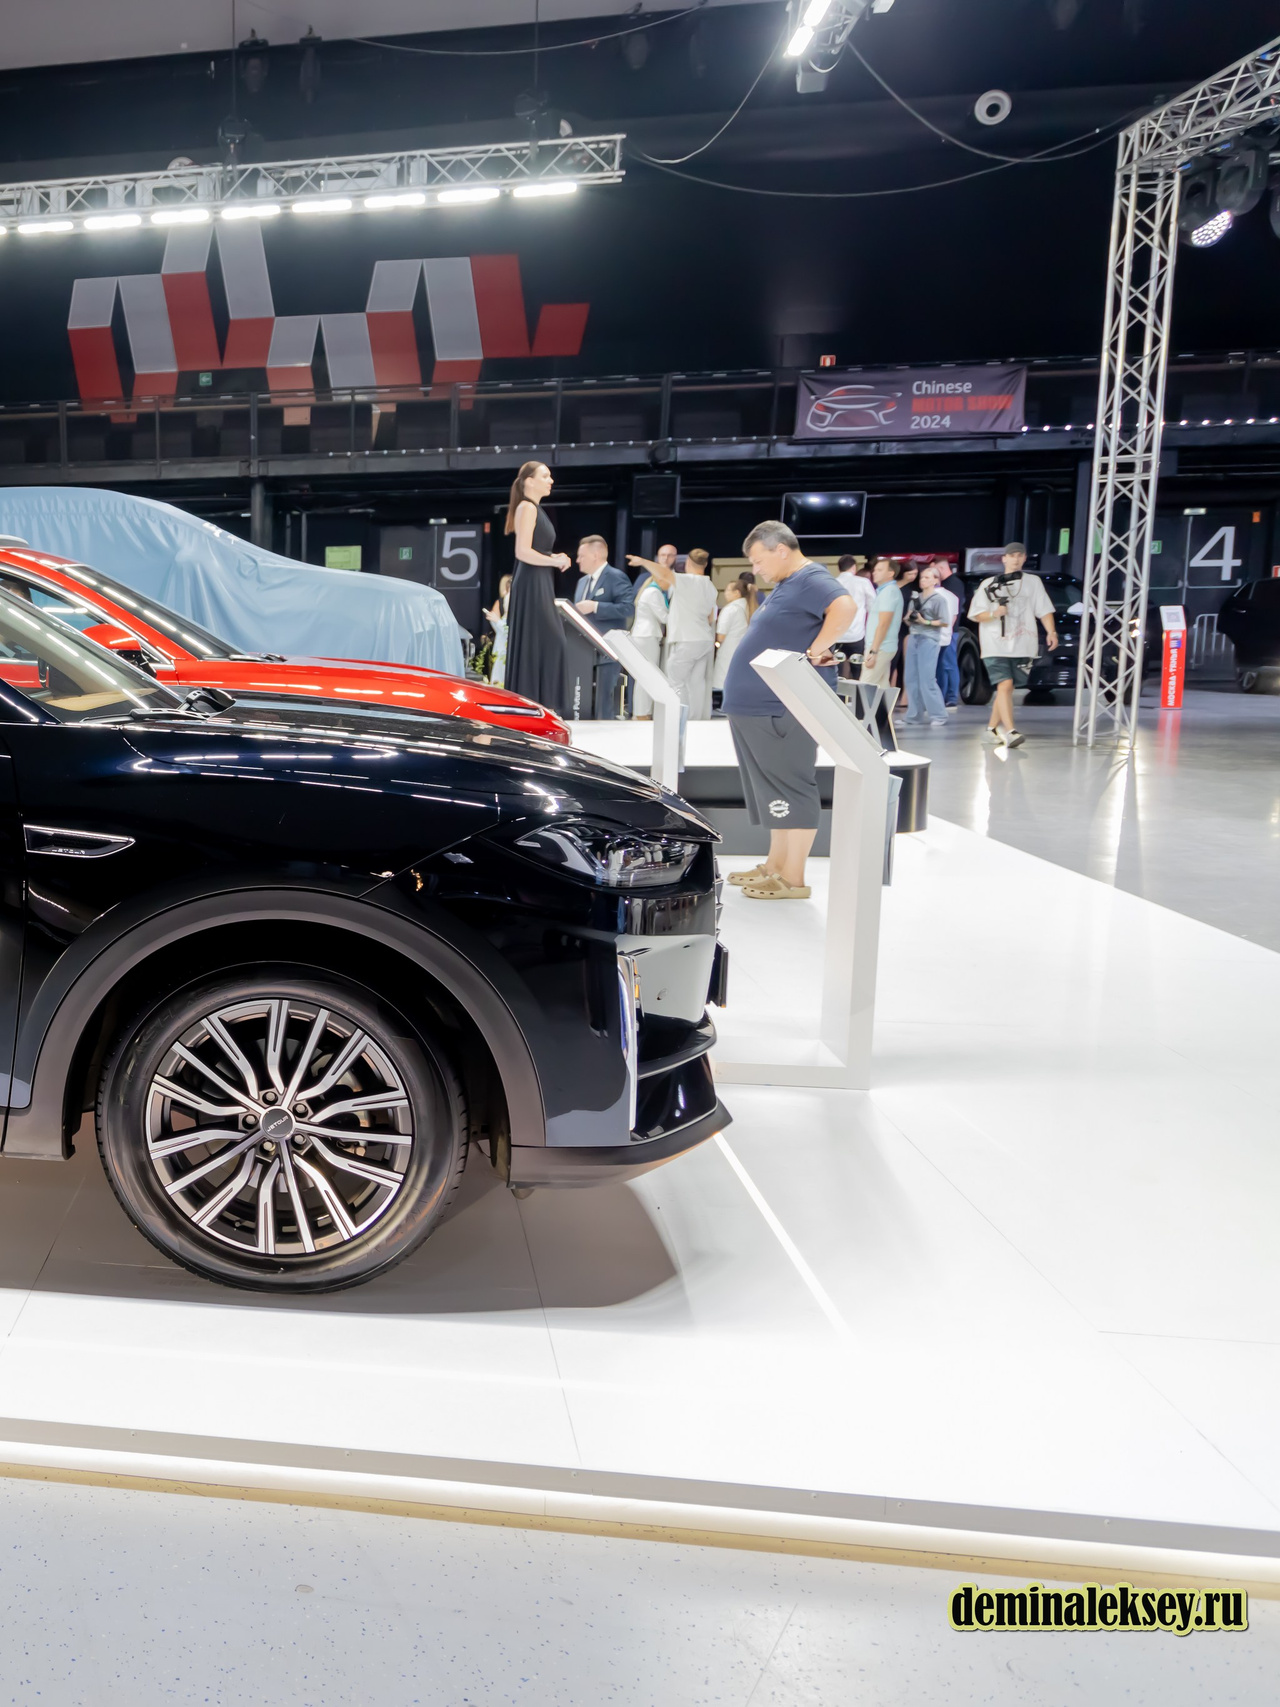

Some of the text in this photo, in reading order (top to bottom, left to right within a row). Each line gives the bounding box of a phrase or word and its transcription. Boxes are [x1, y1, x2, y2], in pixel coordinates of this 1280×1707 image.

[912, 381, 972, 395] Chinese
[910, 415, 951, 429] 2024
[439, 530, 479, 582] 5
[1189, 526, 1242, 581] 4
